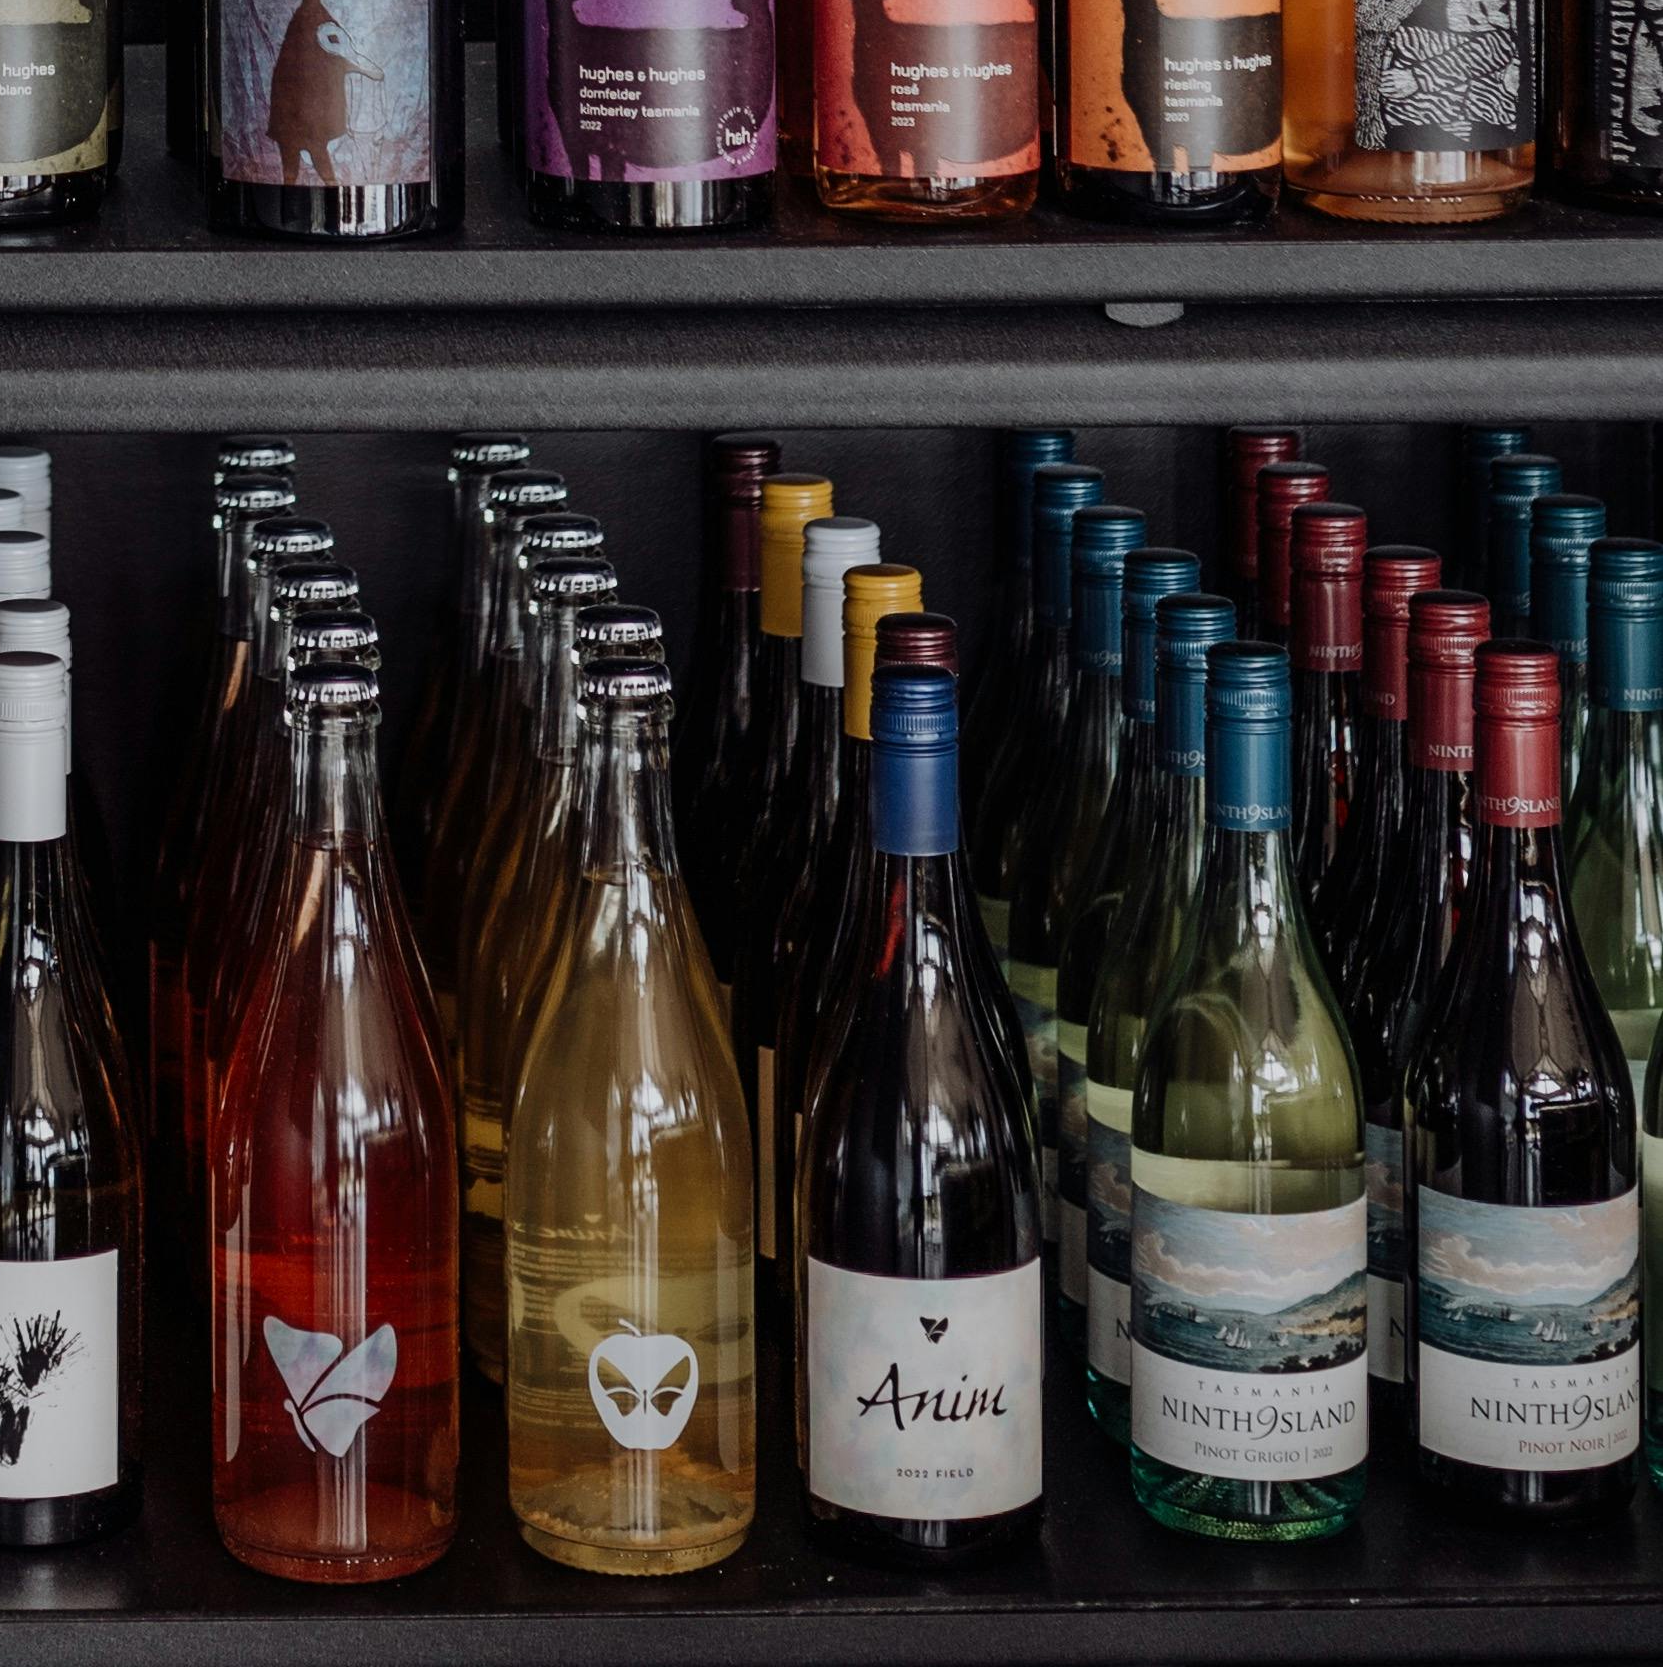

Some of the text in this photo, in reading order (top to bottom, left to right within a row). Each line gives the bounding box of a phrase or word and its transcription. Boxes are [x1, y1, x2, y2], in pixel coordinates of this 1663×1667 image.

[2, 62, 56, 79] hughes
[891, 62, 1012, 81] hughes & hughes
[1164, 53, 1272, 75] hughes & hughes
[579, 65, 706, 85] hughes & hughes
[580, 86, 642, 101] dornfelder
[1164, 78, 1211, 93] riesling
[891, 100, 950, 113] tasmania
[1164, 95, 1223, 107] tasmania
[580, 102, 700, 119] kimberley tasmania
[1164, 112, 1189, 122] 2023
[580, 120, 602, 131] 2022
[891, 117, 915, 127] 2023
[725, 126, 750, 146] h&h
[1513, 1366, 1629, 1389] TASMANIA
[857, 1362, 1007, 1431] Anim
[1197, 1380, 1330, 1396] TASMANIA
[1194, 1441, 1333, 1463] PINOT GRIGIO 2022
[1519, 1440, 1564, 1454] PINOT
[1569, 1437, 1605, 1453] NOIR
[896, 1467, 974, 1478] 2022 FIELD
